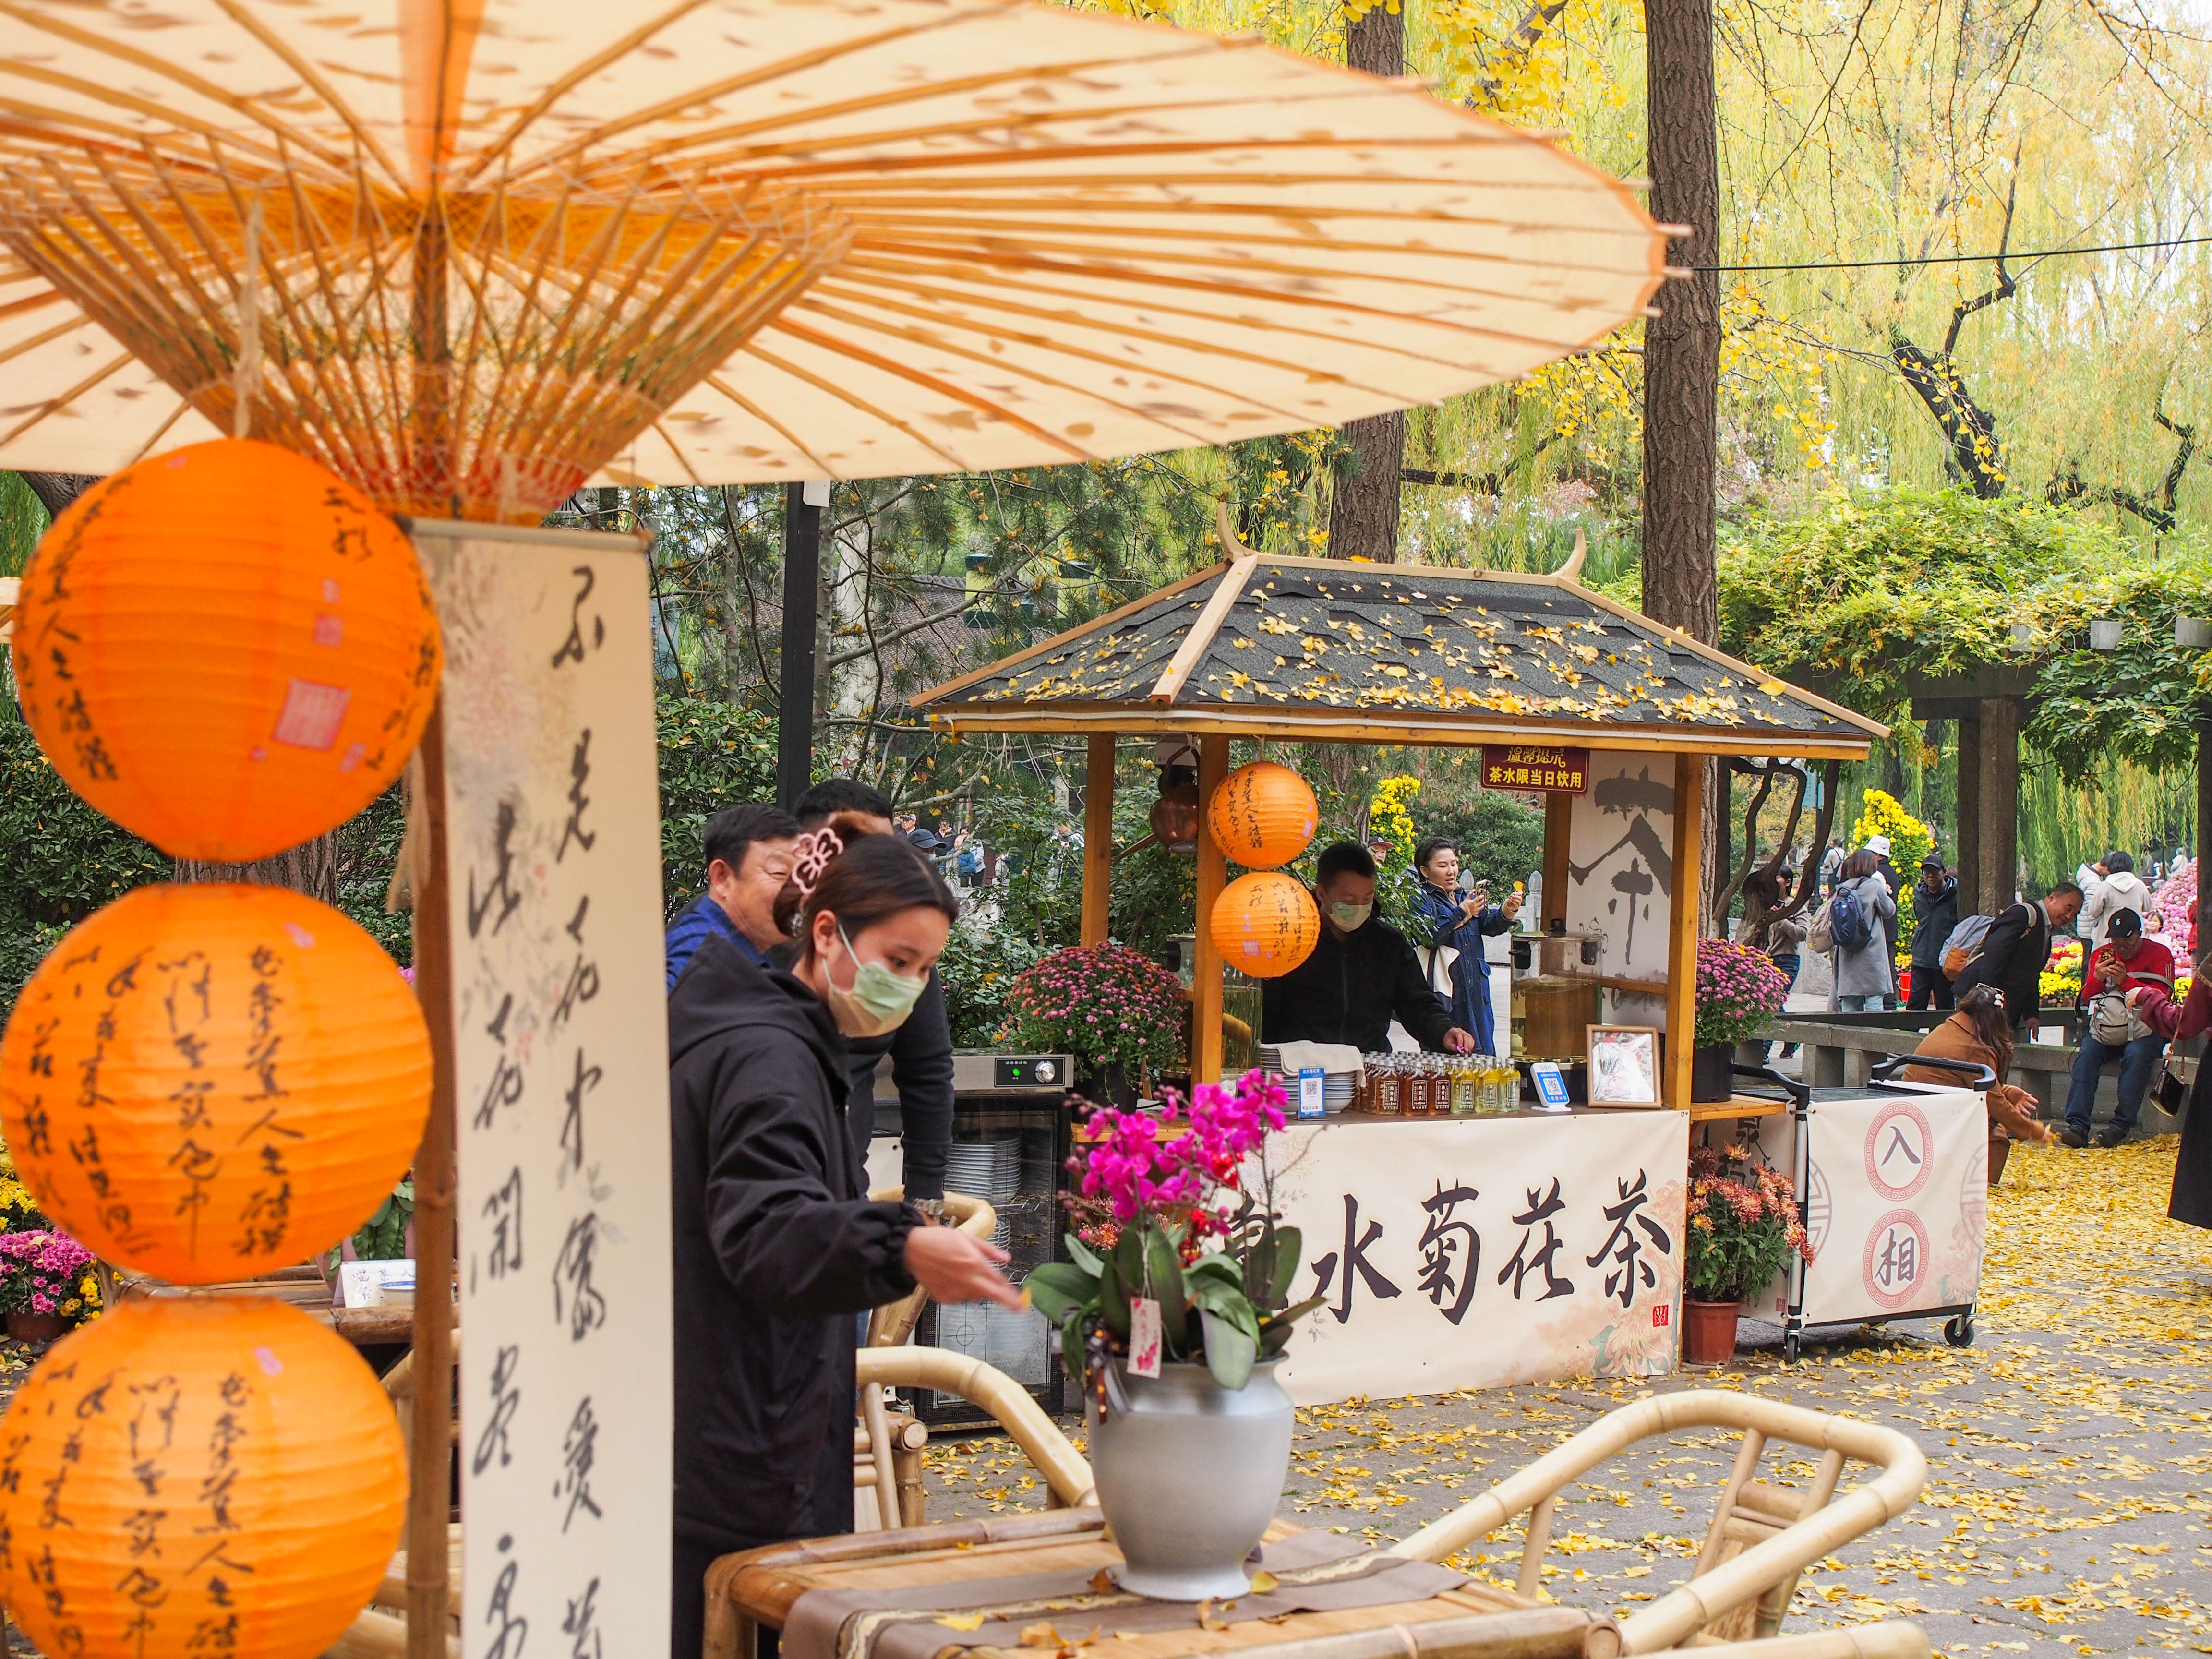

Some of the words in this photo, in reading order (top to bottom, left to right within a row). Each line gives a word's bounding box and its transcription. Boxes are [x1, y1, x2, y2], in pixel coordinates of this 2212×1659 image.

[1503, 746, 1566, 768] 温馨提示
[1489, 766, 1582, 788] 茶水限当日饮用
